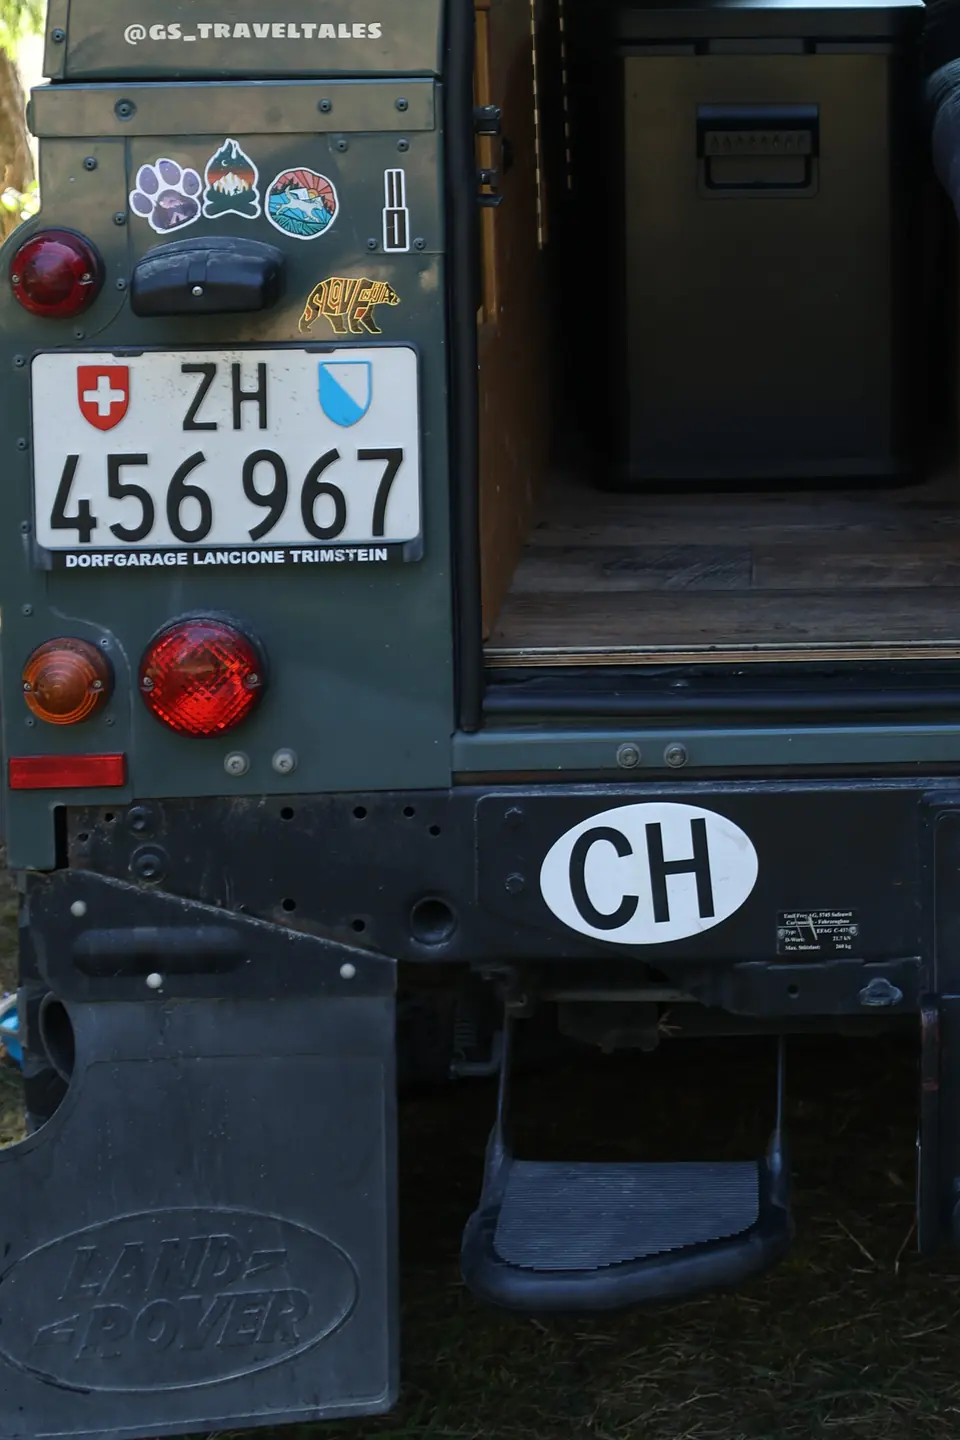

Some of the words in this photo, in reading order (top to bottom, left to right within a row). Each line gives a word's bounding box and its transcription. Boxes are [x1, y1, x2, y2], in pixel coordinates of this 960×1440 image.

[123, 22, 383, 45] @GS_TRAVELTALES
[180, 362, 270, 432] ZH
[65, 553, 189, 568] DORFGARAGE
[192, 550, 285, 566] LANCIONE
[289, 547, 388, 564] TRIMSTEIN
[567, 817, 717, 931] CH
[58, 1233, 246, 1302] LAND
[73, 1288, 311, 1363] ROVER
